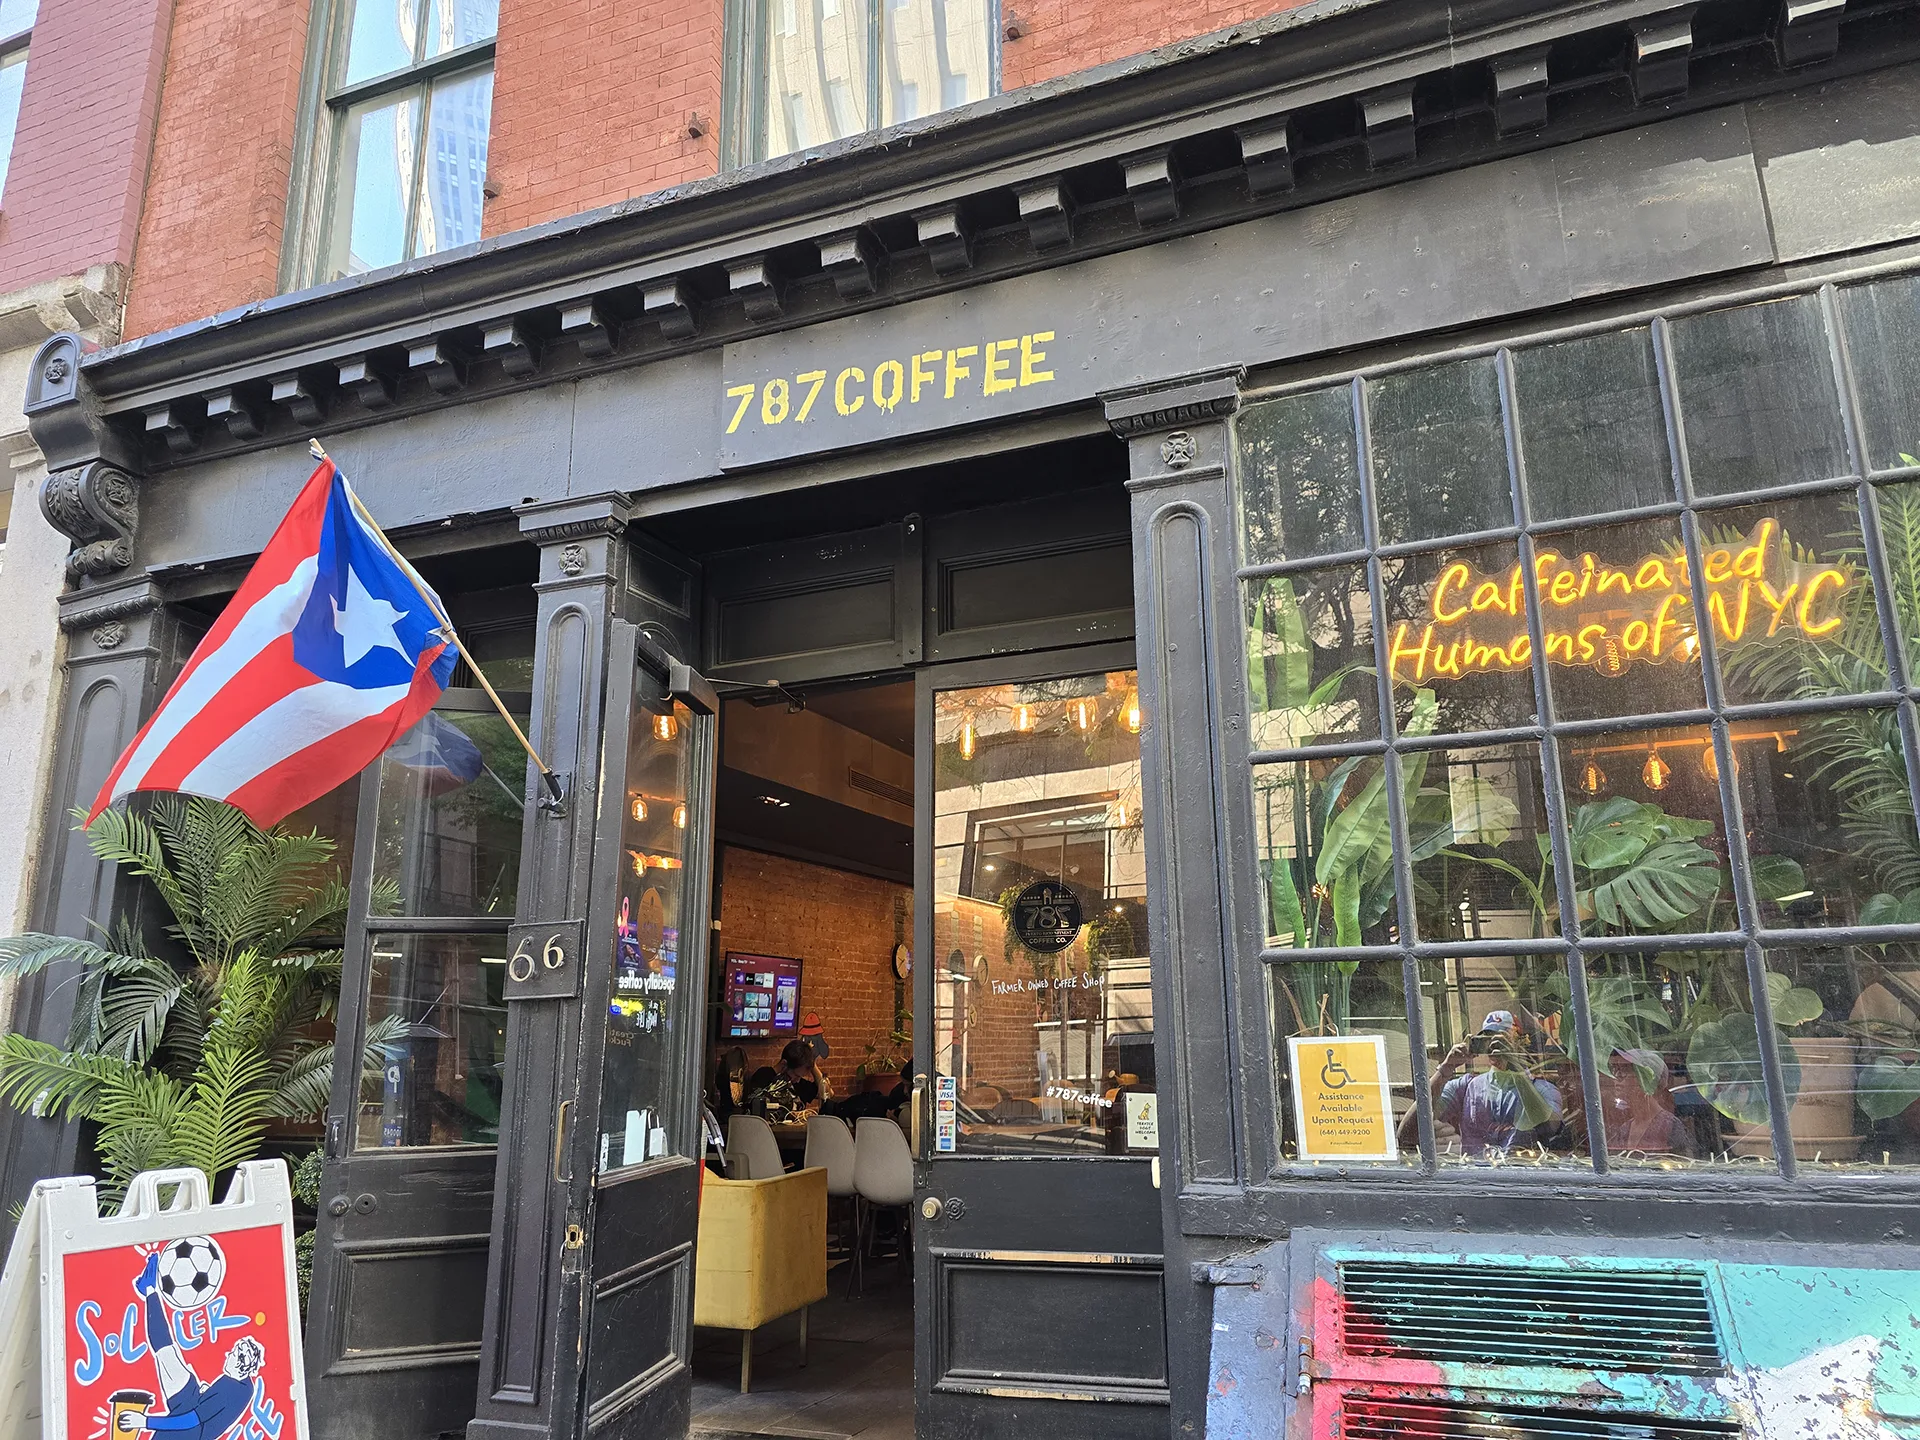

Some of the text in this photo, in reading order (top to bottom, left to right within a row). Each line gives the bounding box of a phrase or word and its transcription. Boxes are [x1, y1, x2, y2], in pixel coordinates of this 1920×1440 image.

[1433, 521, 1773, 622] Caffeinated
[1388, 569, 1845, 681] Humans of NYC
[508, 933, 564, 982] 66
[991, 979, 1025, 995] FARMER
[1046, 1085, 1113, 1108] #787coffee
[1320, 1104, 1362, 1112] Available
[1311, 1116, 1374, 1126] Upon Request
